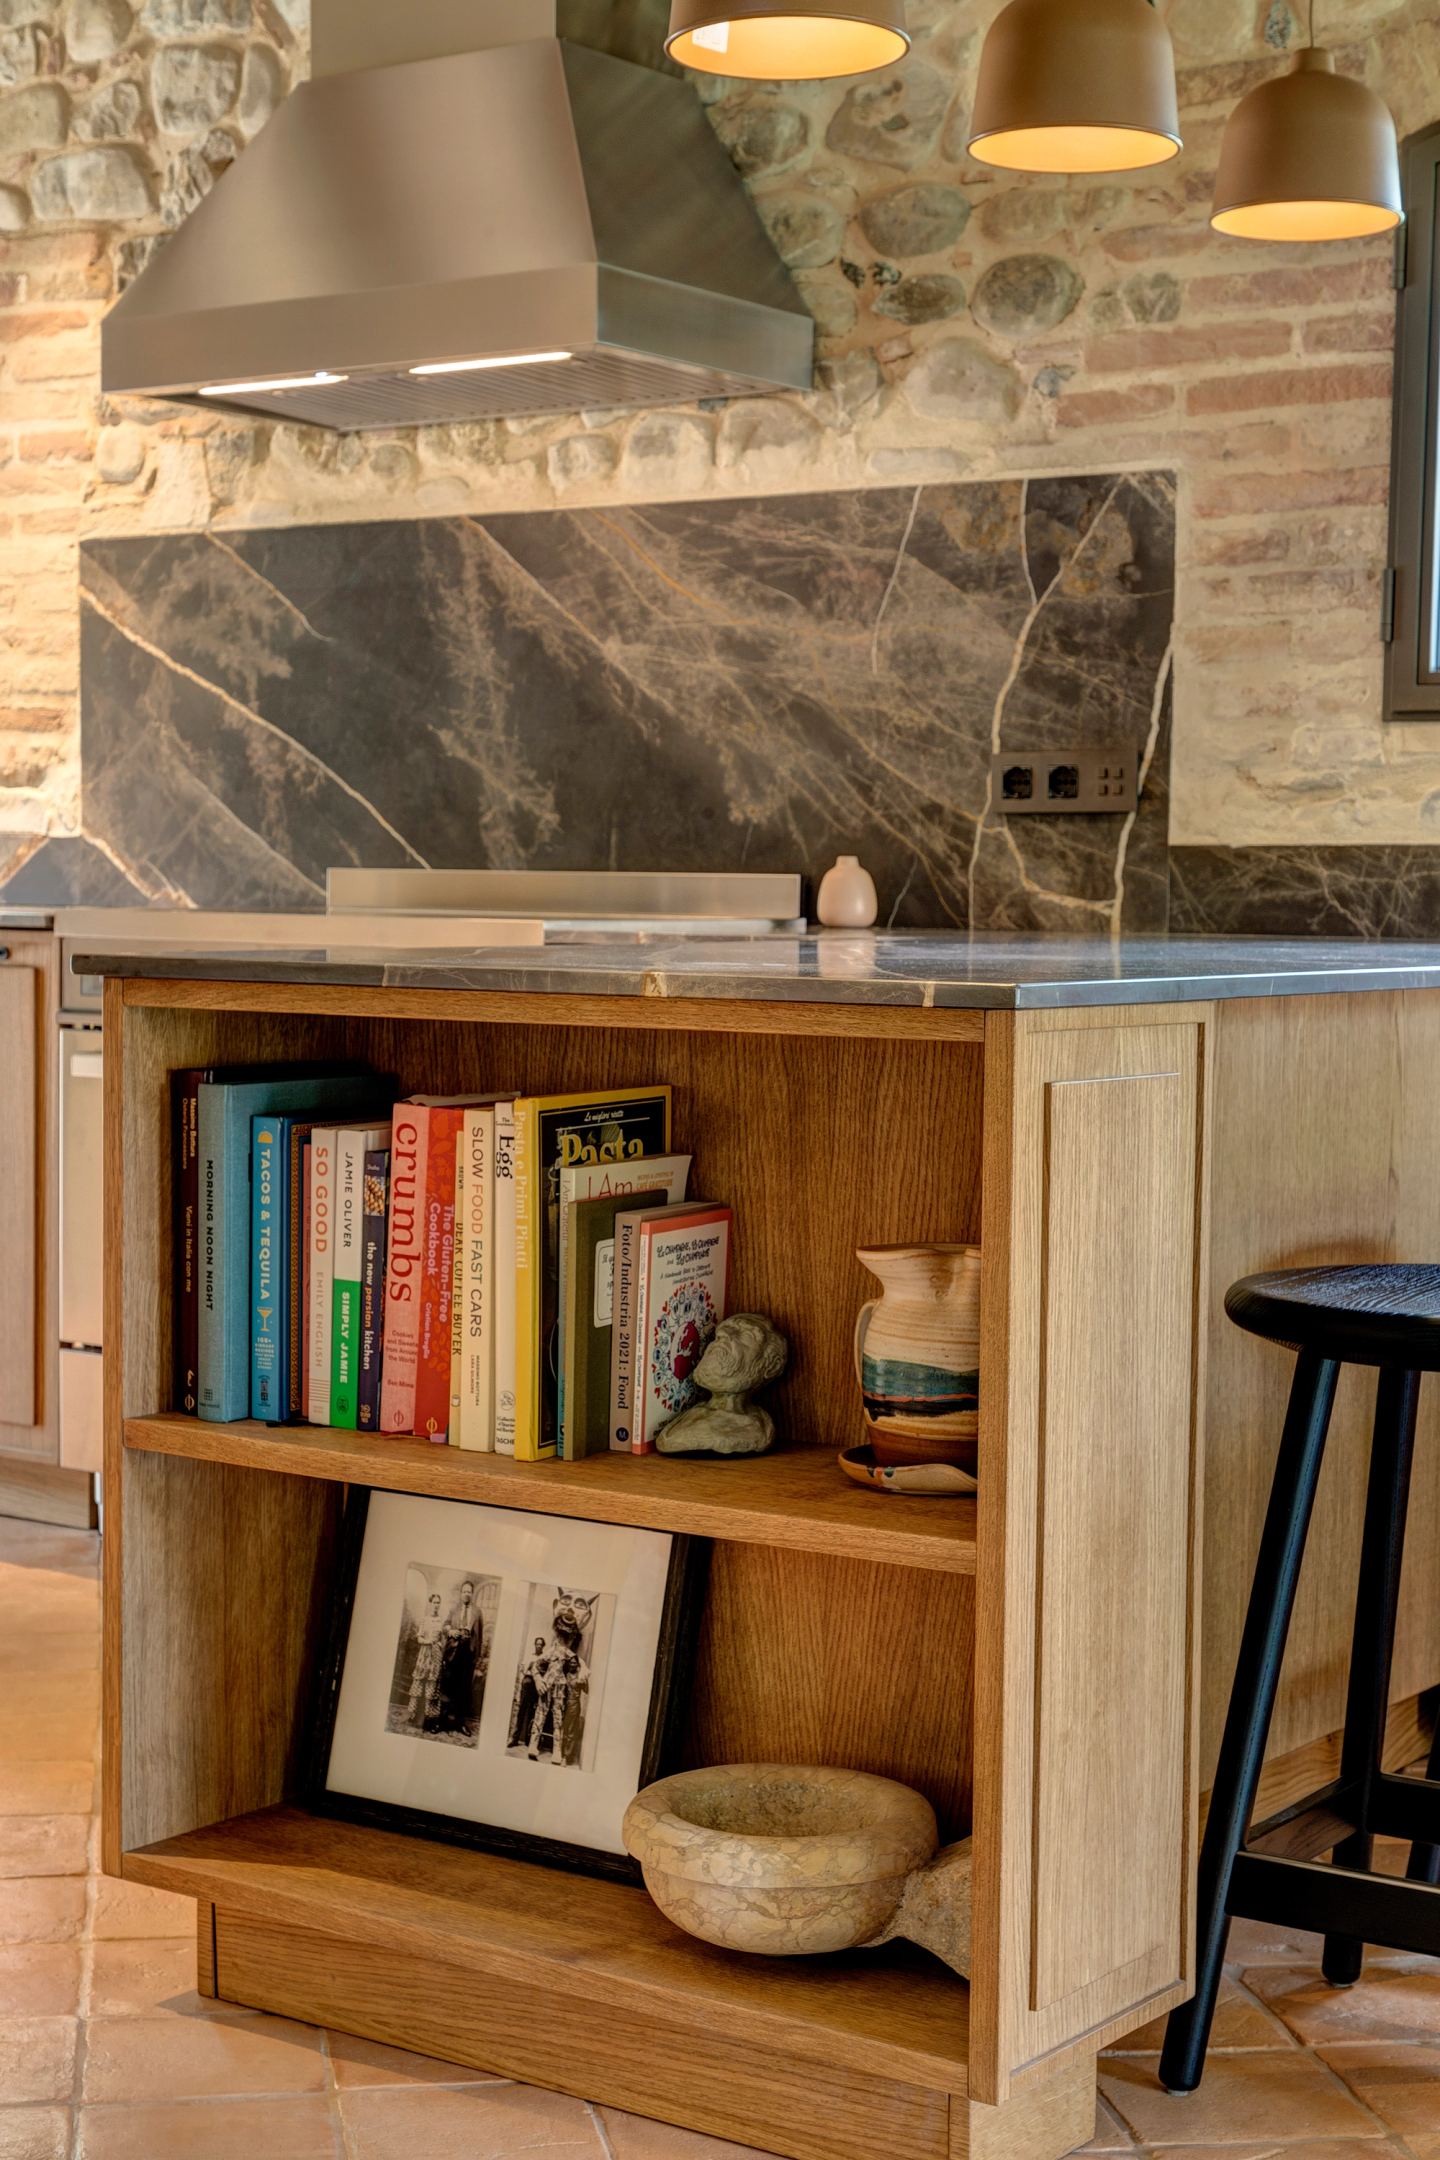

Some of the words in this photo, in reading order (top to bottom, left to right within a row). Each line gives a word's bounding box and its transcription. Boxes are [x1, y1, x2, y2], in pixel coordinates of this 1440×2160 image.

[189, 1098, 197, 1130] Massimo
[514, 1111, 527, 1155] Pasta
[189, 1131, 197, 1157] Bottura
[316, 1147, 329, 1176] SO
[472, 1126, 483, 1178] SLOW
[496, 1135, 515, 1179] Egg
[560, 1129, 643, 1167] Pasta
[261, 1149, 271, 1205] TACOS
[344, 1152, 353, 1194] JAMIE
[515, 1161, 524, 1170] e
[588, 1176, 592, 1199] I
[599, 1172, 633, 1198] Am
[206, 1160, 214, 1221] MORNING
[471, 1184, 483, 1235] FOOD
[515, 1175, 528, 1220] Primi
[185, 1206, 193, 1226] Vieni
[185, 1229, 193, 1237] in
[261, 1210, 271, 1221] &
[316, 1185, 328, 1253] GOOD
[343, 1199, 352, 1248] OLIVER
[390, 1123, 421, 1302] crumbs
[442, 1204, 455, 1231] The
[185, 1239, 193, 1259] Italia
[206, 1226, 214, 1265] NOON
[366, 1242, 377, 1259] the
[427, 1202, 441, 1275] Cookbook
[455, 1222, 464, 1255] DEAR
[514, 1225, 528, 1268] Piatti
[259, 1227, 271, 1300] TEQUILA
[439, 1234, 453, 1322] Gluten-Free
[471, 1239, 482, 1285] FAST
[619, 1224, 633, 1327] Foto/Industria
[185, 1279, 192, 1293] me
[315, 1271, 324, 1308] EMILY
[364, 1287, 373, 1327] persian
[341, 1292, 350, 1340] SIMPLY
[424, 1302, 432, 1331] Cristian
[470, 1288, 482, 1338] CARS
[315, 1313, 323, 1368] ENGLISH
[363, 1330, 374, 1370] kitchen
[452, 1313, 463, 1356] BUYER
[618, 1332, 631, 1370] 2021:
[340, 1342, 349, 1384] JAMIE
[617, 1375, 630, 1410] Food
